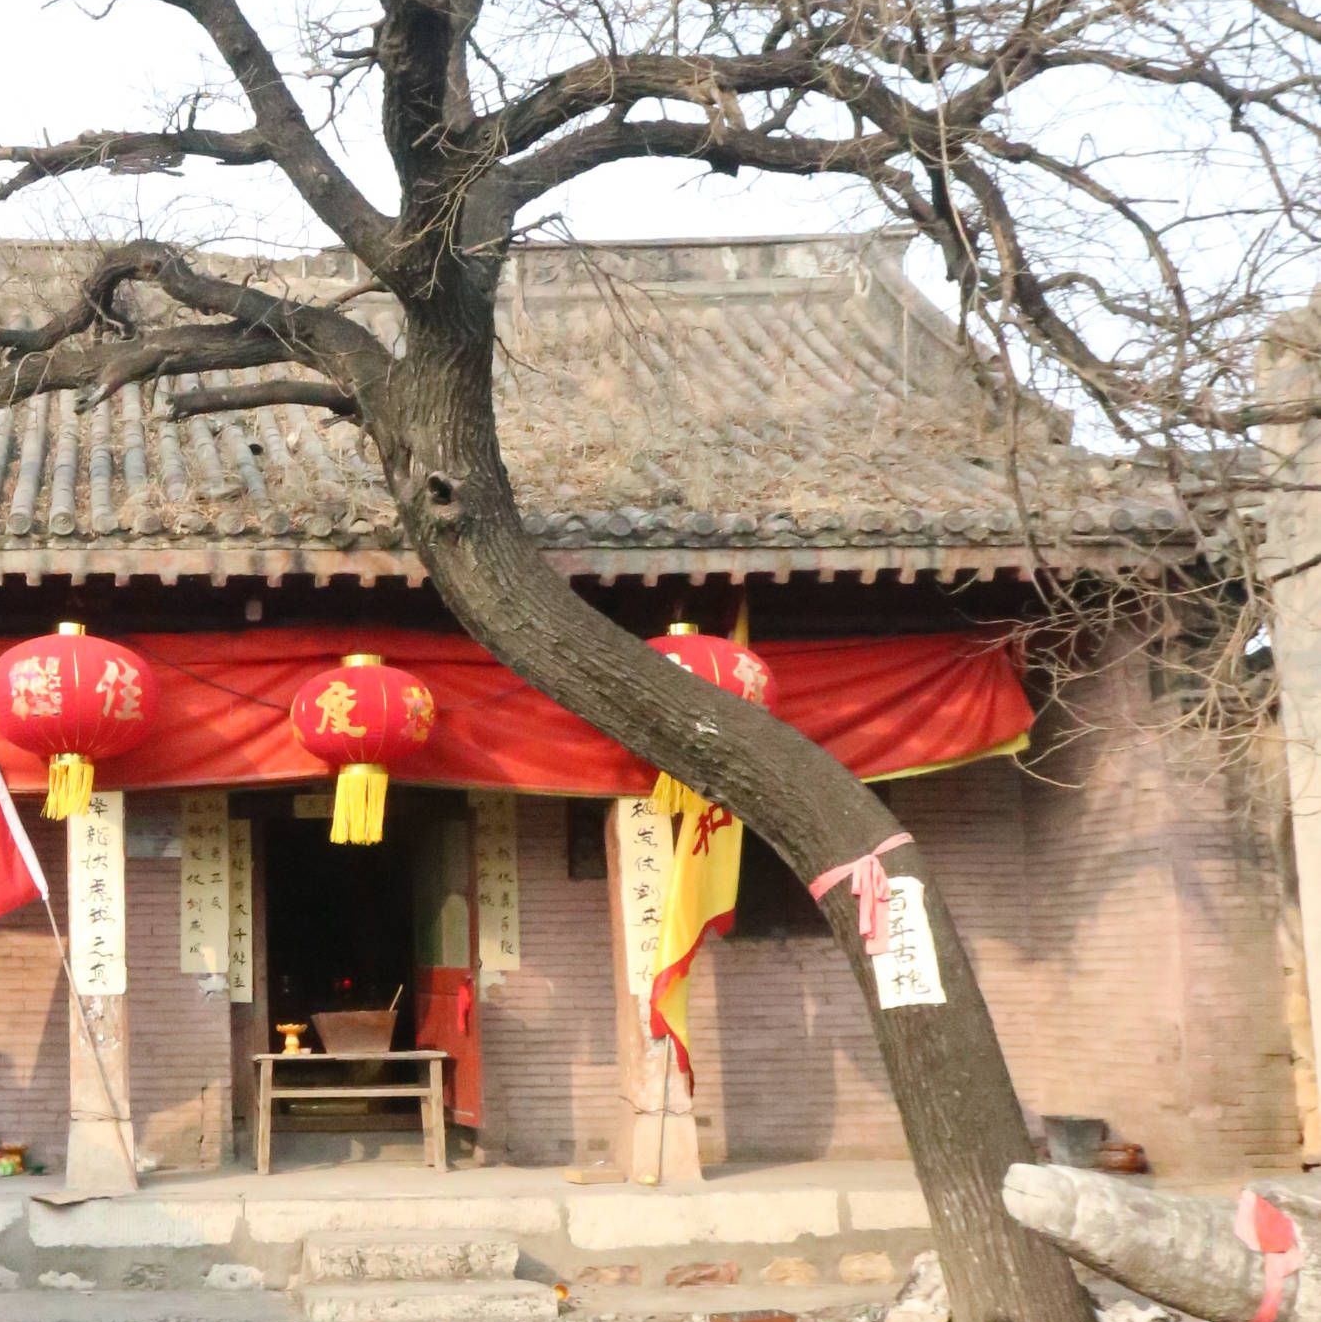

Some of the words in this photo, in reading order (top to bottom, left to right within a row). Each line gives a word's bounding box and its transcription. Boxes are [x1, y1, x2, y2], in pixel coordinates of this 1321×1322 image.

[96, 657, 143, 720] 佳
[315, 681, 367, 738] 度
[692, 802, 733, 857] 和
[888, 888, 932, 995] 百年古槐
